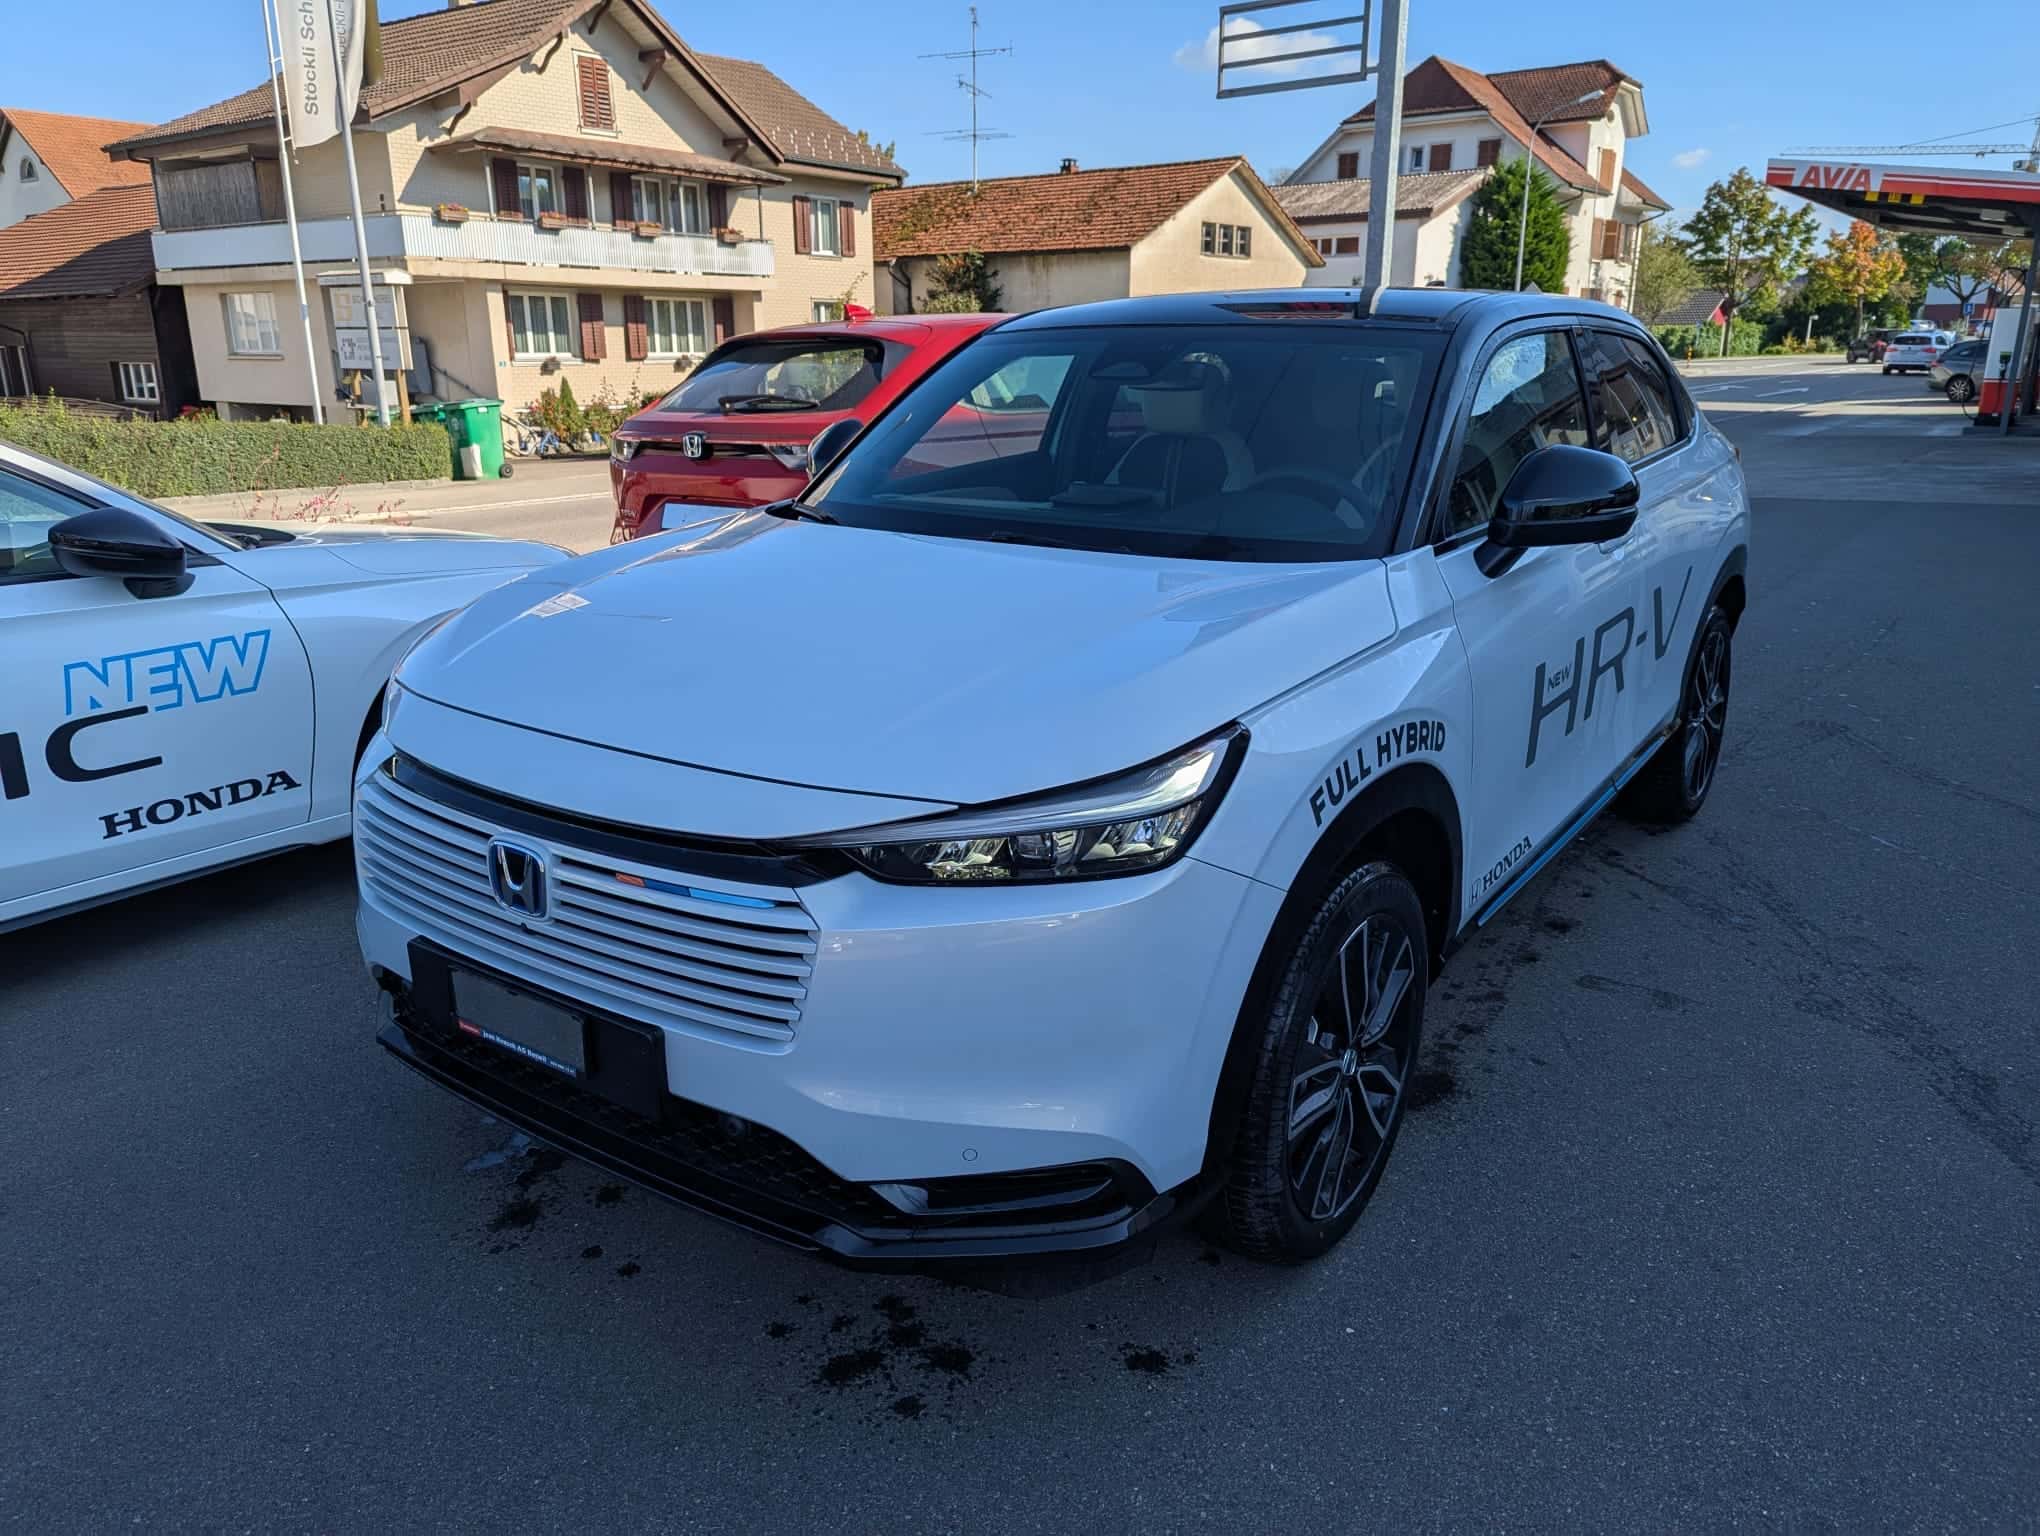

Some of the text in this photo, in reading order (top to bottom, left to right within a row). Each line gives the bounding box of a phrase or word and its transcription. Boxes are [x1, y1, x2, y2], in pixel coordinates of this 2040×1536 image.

[298, 0, 318, 115] Stöckli Sch
[1801, 165, 1871, 191] AVIA
[63, 629, 271, 716] NEW
[1525, 565, 1693, 768] HR-V
[1547, 664, 1572, 692] NEW
[98, 770, 302, 840] HONDA
[1309, 720, 1446, 827] FULL HYBRID
[1482, 835, 1533, 893] HONDA
